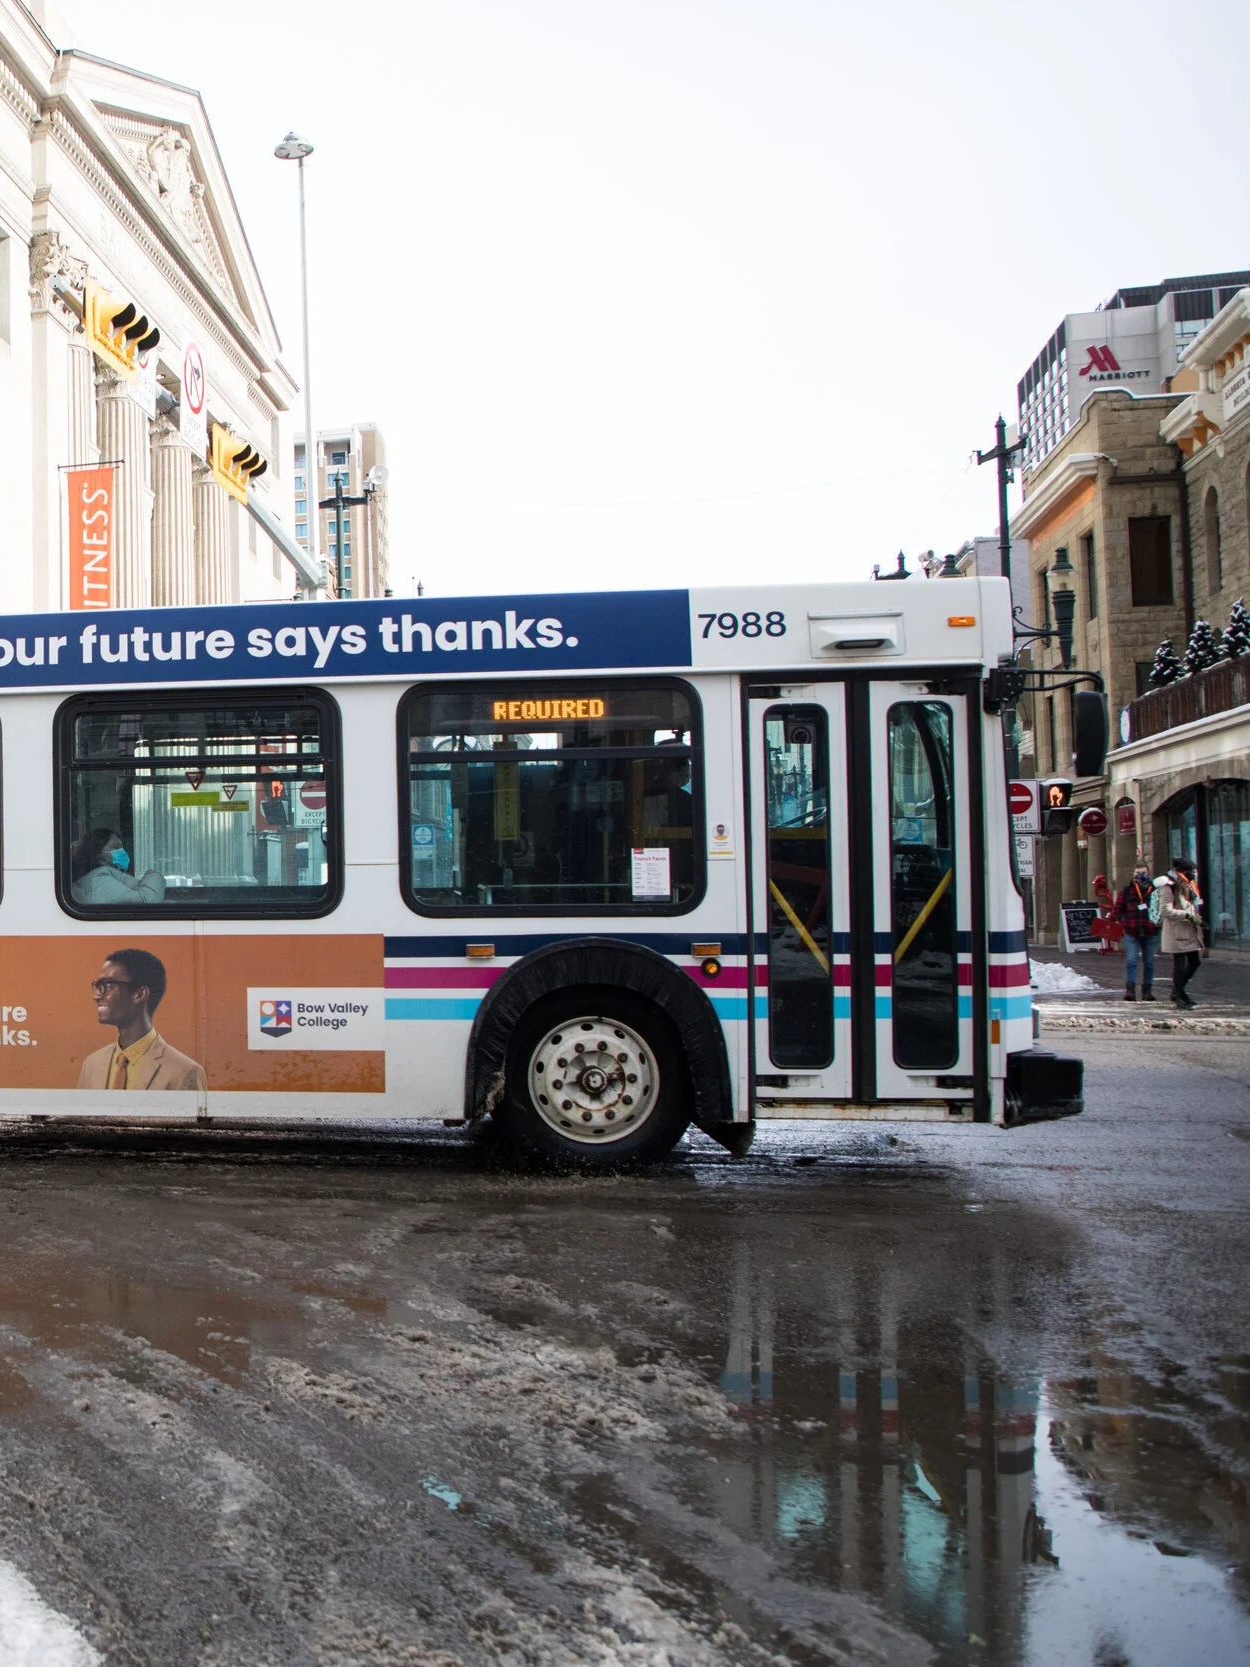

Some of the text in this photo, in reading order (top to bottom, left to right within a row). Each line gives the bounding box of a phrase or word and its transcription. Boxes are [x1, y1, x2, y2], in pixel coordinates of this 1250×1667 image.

[1089, 369, 1150, 382] MARRIOTT
[82, 489, 109, 607] ITNESS
[698, 611, 787, 639] 7988
[79, 623, 236, 664] future
[247, 625, 367, 668] says
[379, 610, 580, 655] thanks.
[493, 699, 604, 720] REQUIRED
[297, 1002, 369, 1017] Bow Valley
[297, 1016, 348, 1031] College
